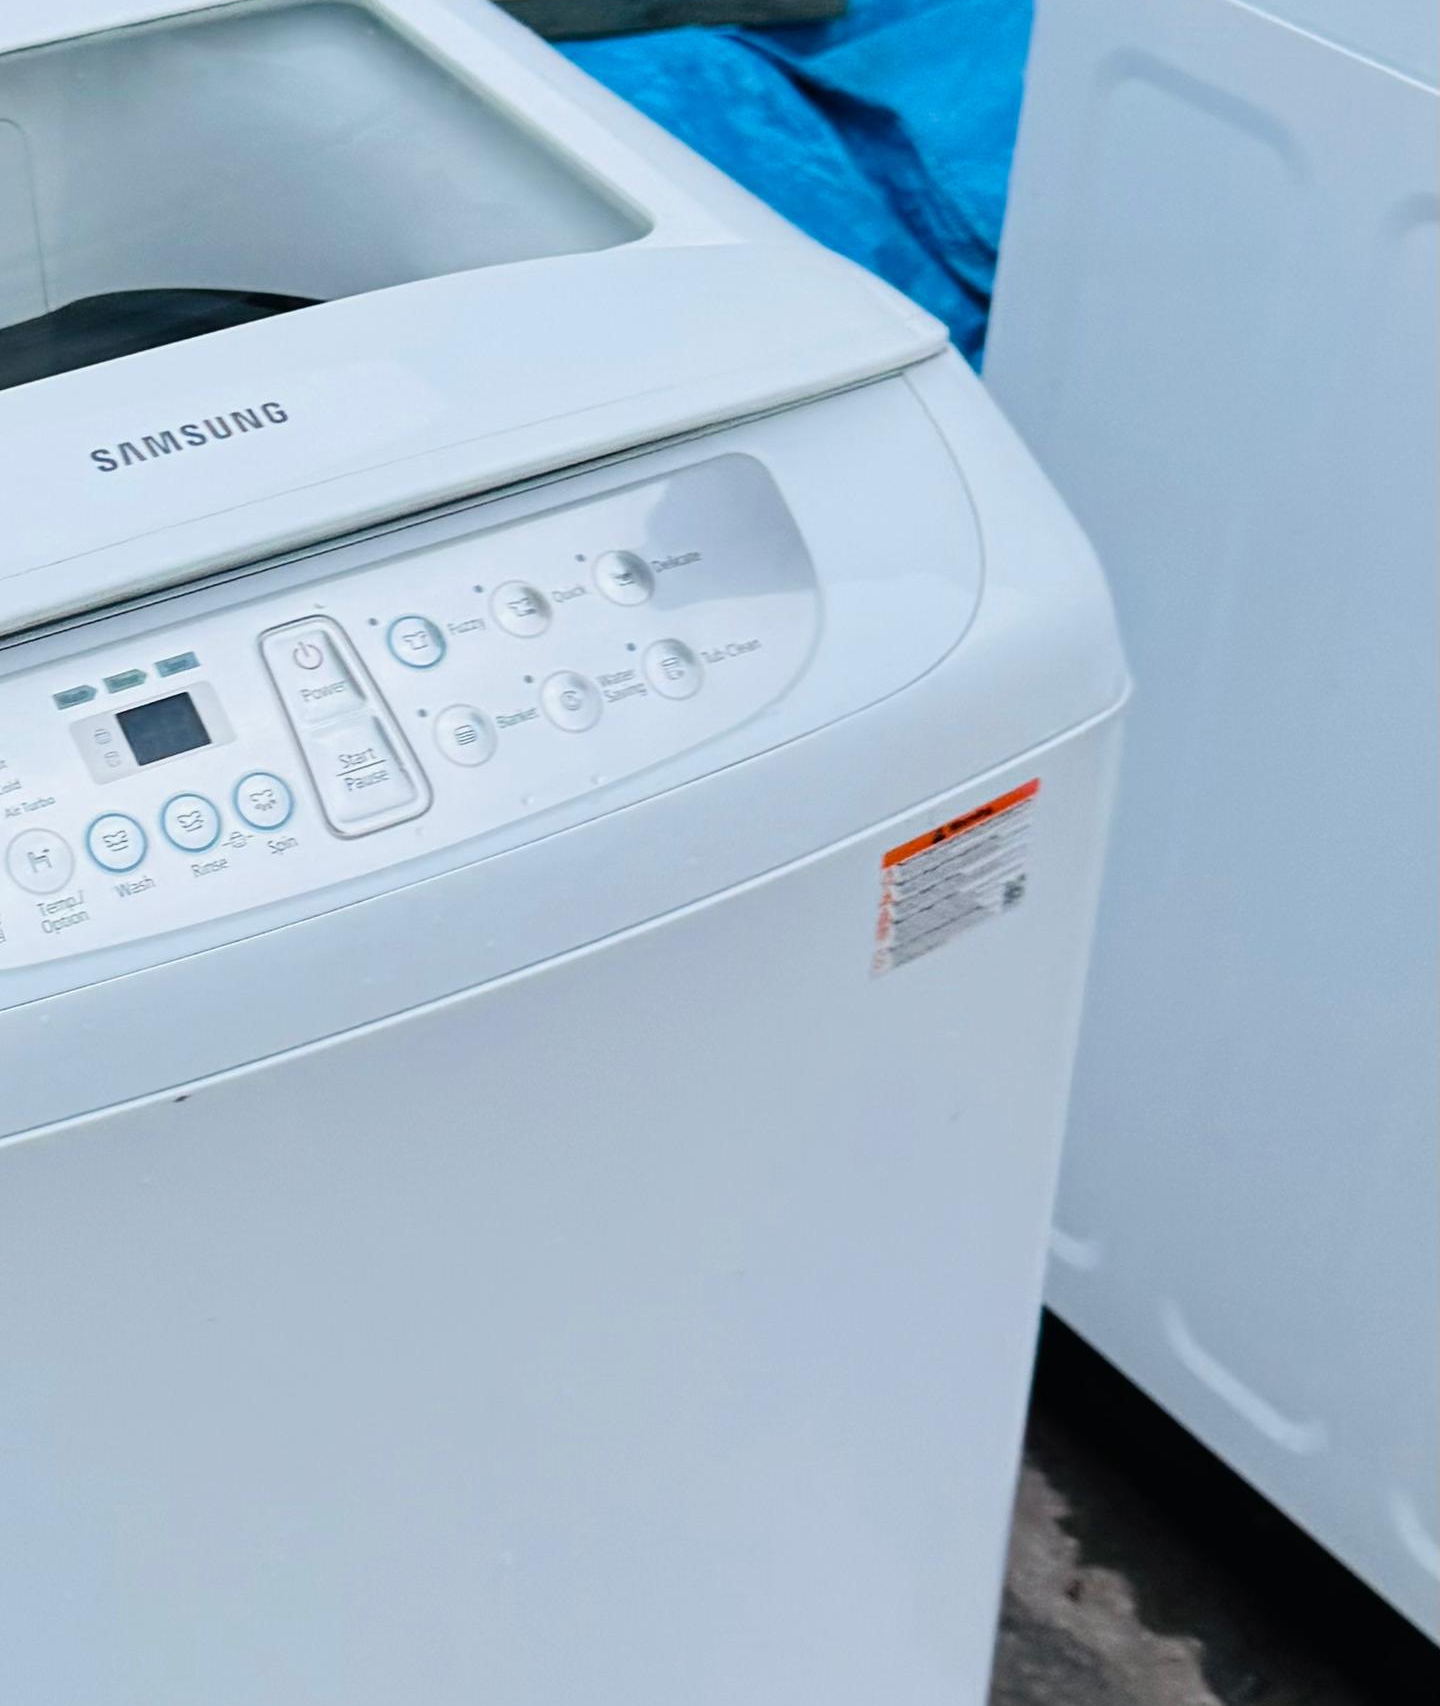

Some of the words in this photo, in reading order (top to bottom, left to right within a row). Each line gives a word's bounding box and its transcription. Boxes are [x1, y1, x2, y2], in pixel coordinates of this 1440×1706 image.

[90, 401, 289, 473] SAMSUNG
[300, 679, 348, 702] Power
[337, 748, 377, 769] Start
[343, 769, 391, 792] Pause
[267, 836, 300, 856] Spin
[191, 858, 230, 878] Rinse
[114, 876, 157, 898] Wash
[41, 909, 91, 935] Option
